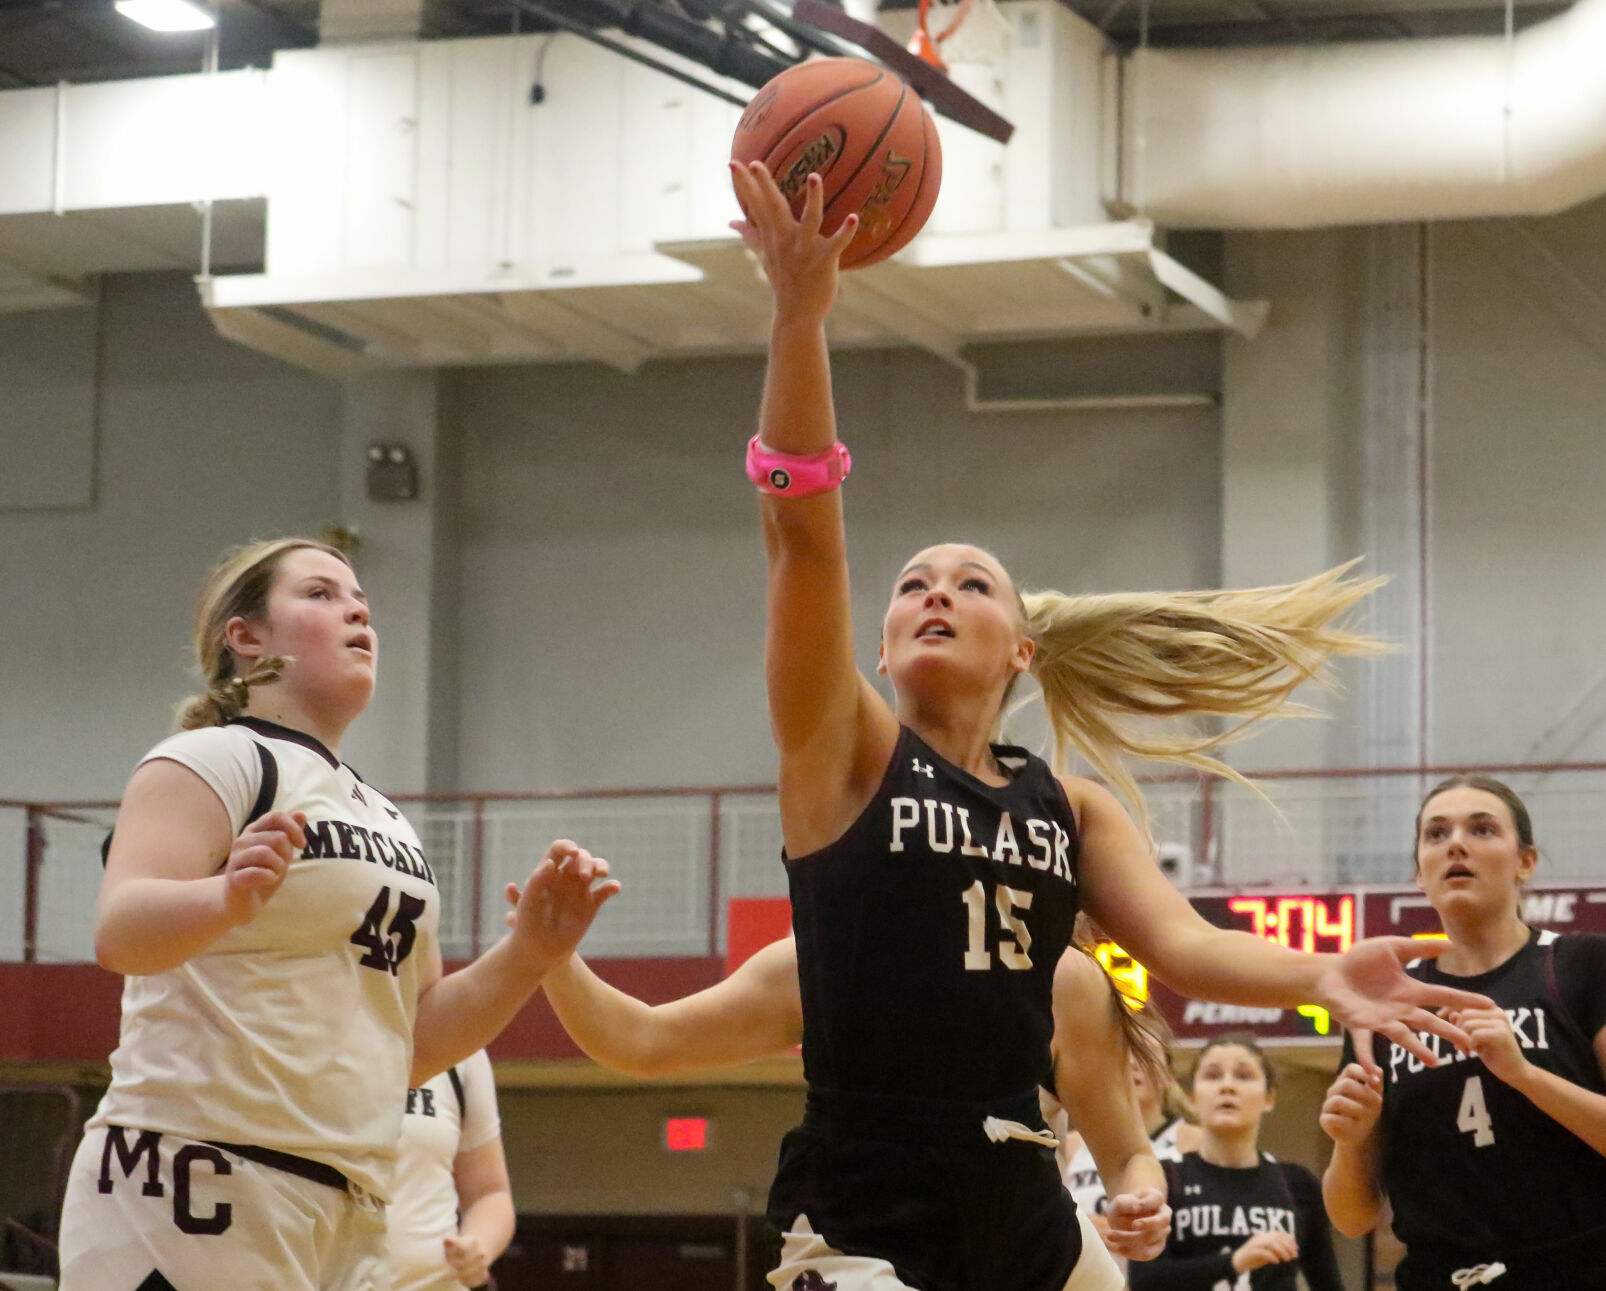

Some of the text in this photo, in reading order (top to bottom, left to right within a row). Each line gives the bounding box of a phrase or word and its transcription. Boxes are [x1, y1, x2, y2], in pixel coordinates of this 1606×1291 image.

[889, 796, 1077, 886] PULASK
[962, 879, 1034, 971] 15
[1229, 896, 1355, 954] 7:04
[1456, 1075, 1496, 1148] 4
[1175, 1204, 1296, 1242] PULASKI
